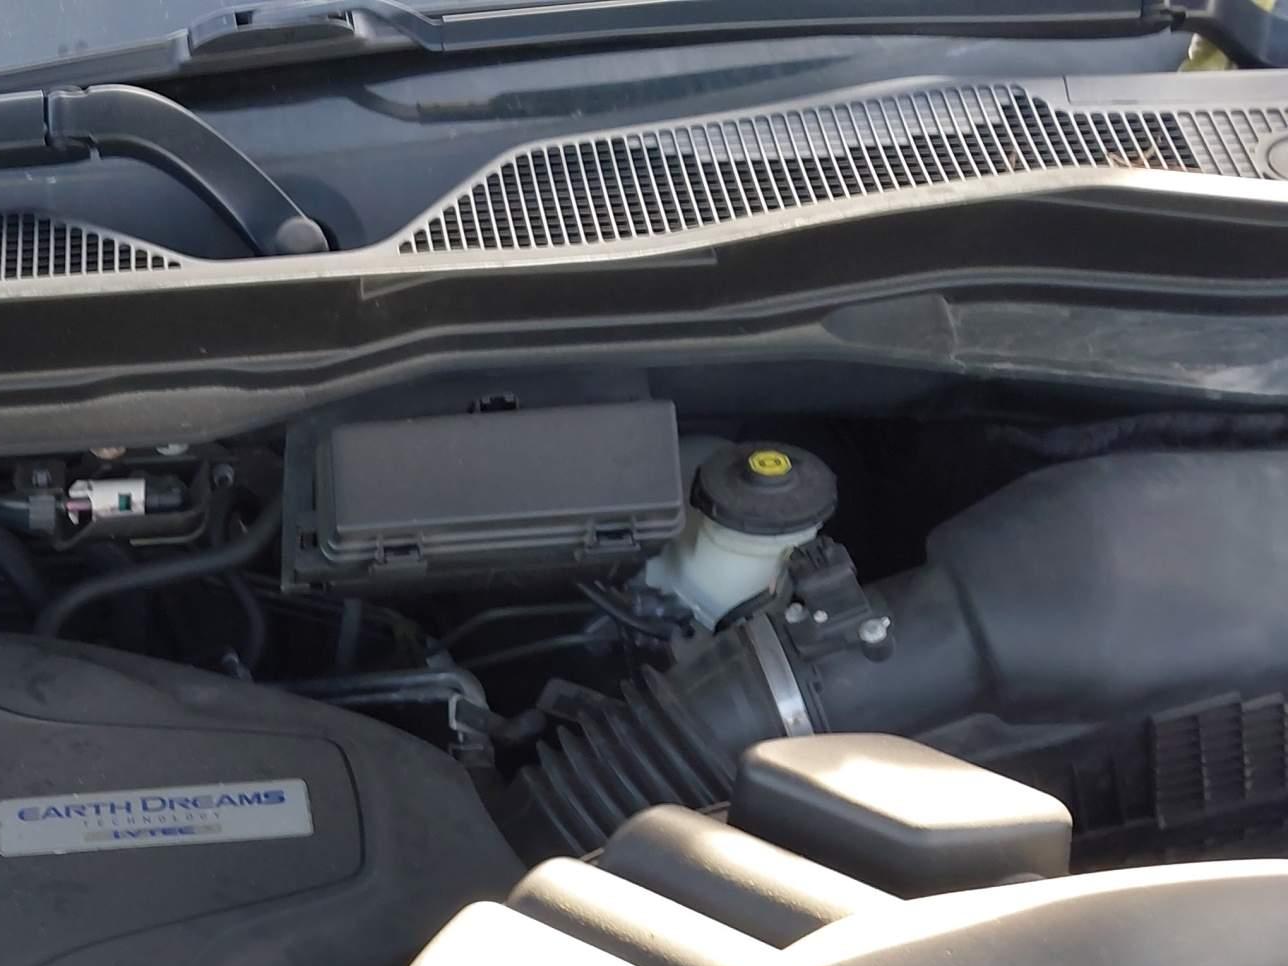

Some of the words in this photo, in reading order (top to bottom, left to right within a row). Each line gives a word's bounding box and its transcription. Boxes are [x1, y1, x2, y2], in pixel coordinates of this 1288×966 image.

[17, 803, 132, 822] EARTH
[140, 789, 286, 812] DREAMS
[83, 811, 222, 827] TECHNOLOGY
